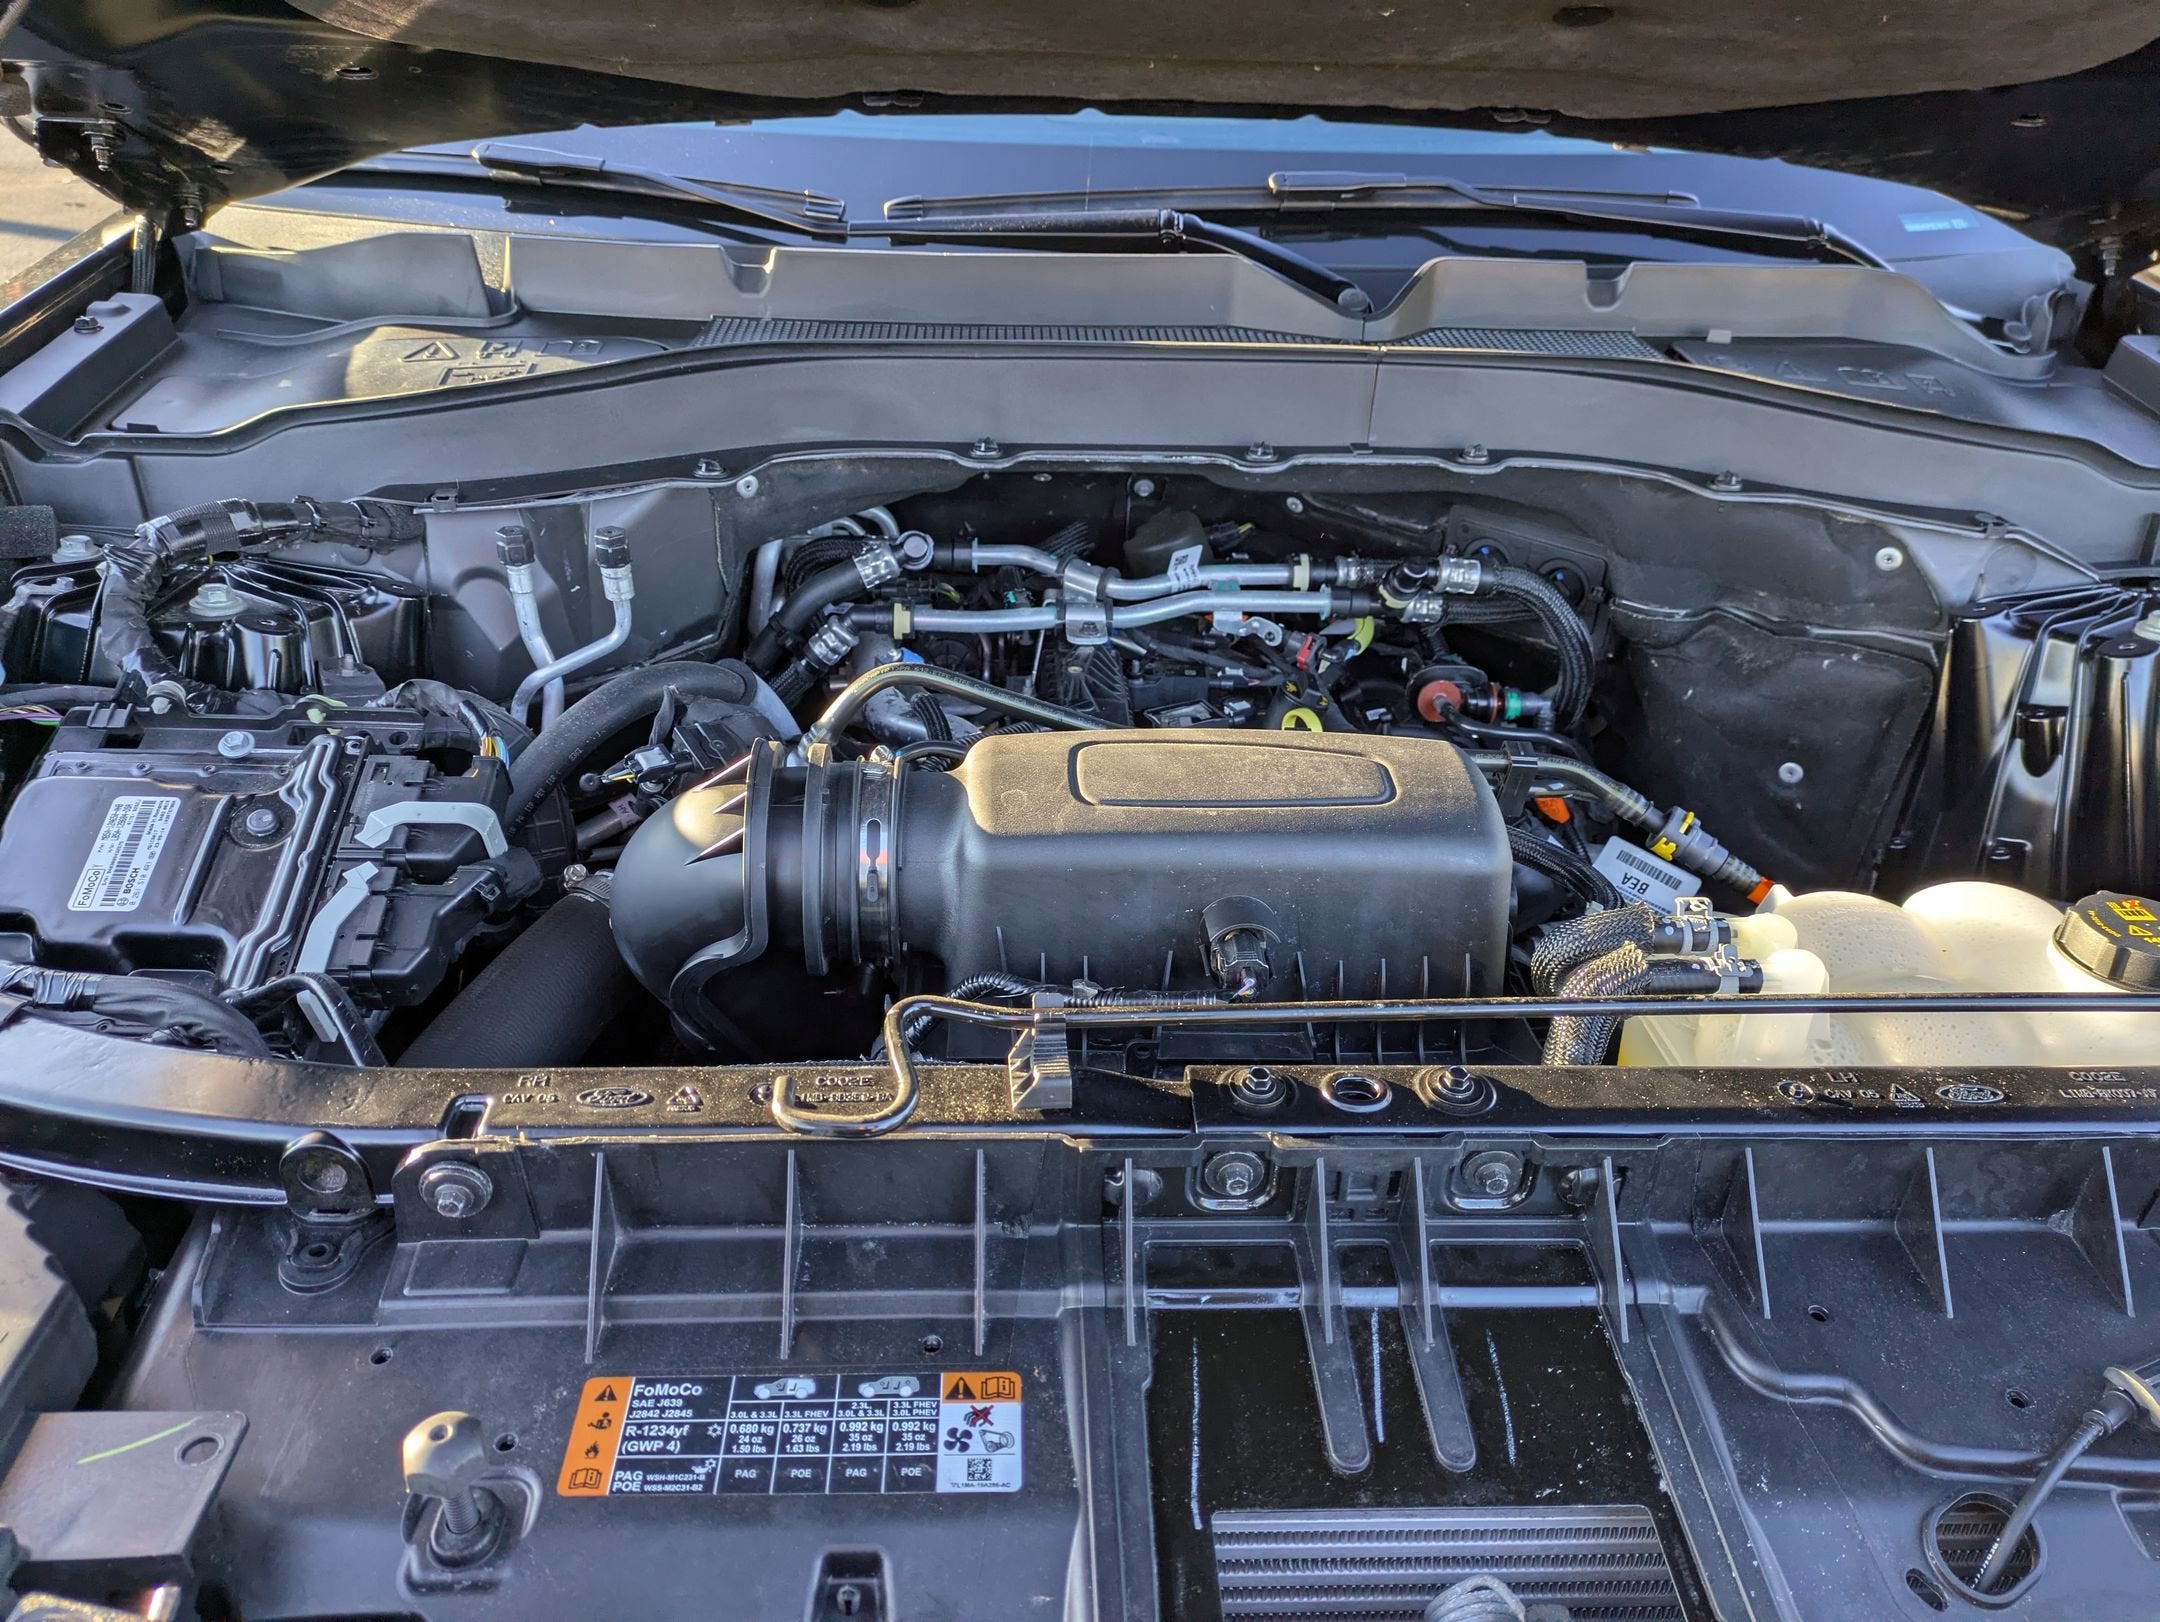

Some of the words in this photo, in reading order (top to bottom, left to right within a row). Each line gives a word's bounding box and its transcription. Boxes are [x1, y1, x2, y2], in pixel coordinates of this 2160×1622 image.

[122, 867, 141, 895] BOSCH
[1621, 872, 1650, 895] BEA
[77, 870, 101, 906] FoMoCo
[1826, 1072, 1859, 1083] LH
[580, 1088, 643, 1107] Ford
[633, 1382, 703, 1397] FoMoCo
[631, 1398, 655, 1408] SAE
[656, 1398, 684, 1407] J639
[893, 1401, 911, 1409] 3.3L
[628, 1409, 660, 1419] J2842
[661, 1408, 693, 1418] J2845
[730, 1411, 749, 1419] 3.0L
[750, 1411, 758, 1419] &
[759, 1410, 778, 1419] 3.3L
[784, 1410, 802, 1418] 3.3L
[804, 1410, 829, 1418] FHEV
[837, 1409, 856, 1417] 3.0L
[857, 1409, 865, 1417] &
[866, 1409, 885, 1417] 3.3L
[892, 1409, 911, 1417] 3.0L
[912, 1408, 937, 1416] PHEV
[624, 1424, 690, 1439] R-1234yf
[729, 1423, 759, 1434] 0.680
[760, 1423, 775, 1436] kg
[782, 1423, 811, 1434] 0.737
[813, 1422, 828, 1435] kg
[839, 1421, 868, 1432] 0.992
[870, 1421, 884, 1434] kg
[892, 1421, 920, 1432] 0.992
[922, 1421, 936, 1433] kg
[738, 1435, 750, 1444] 24
[751, 1436, 763, 1444] oz
[791, 1434, 803, 1443] 26
[804, 1435, 816, 1443] oz
[848, 1433, 860, 1442] 35
[901, 1433, 913, 1441] 35
[621, 1440, 664, 1455] (GWP
[665, 1440, 681, 1454] 4)
[731, 1444, 751, 1454] 1.50
[752, 1444, 767, 1453] lbs
[785, 1444, 804, 1453] 1.63
[805, 1444, 820, 1453] lbs
[842, 1443, 861, 1452] 2.19
[863, 1442, 878, 1451] lbs
[895, 1442, 915, 1451] 2.19
[916, 1442, 931, 1451] lbs
[614, 1470, 643, 1481] PAG
[734, 1469, 757, 1479] PAG
[790, 1468, 812, 1478] POE
[845, 1468, 868, 1477] PAG
[900, 1467, 922, 1477] POE
[612, 1481, 642, 1492] POE
